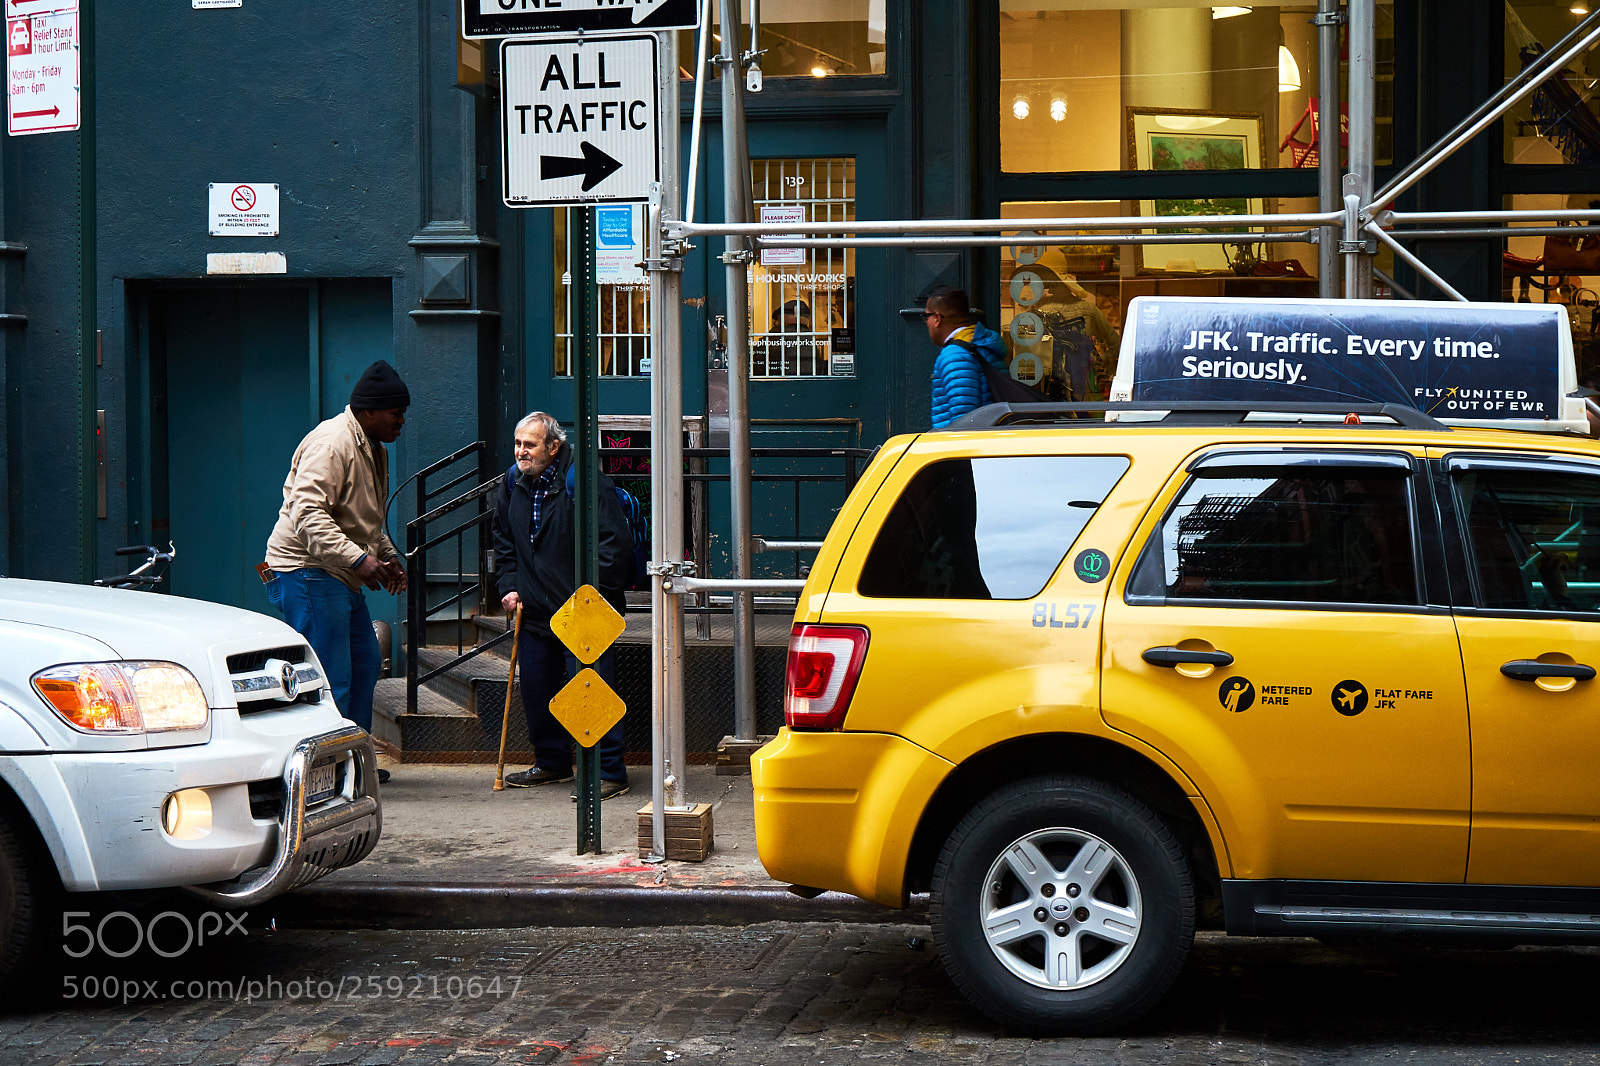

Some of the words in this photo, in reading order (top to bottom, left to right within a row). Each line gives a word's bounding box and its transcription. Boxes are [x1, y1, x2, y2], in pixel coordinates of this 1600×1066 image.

[34, 18, 47, 28] Taxi
[34, 28, 52, 40] Relief
[53, 26, 73, 39] Stand
[34, 43, 37, 54] 1
[38, 42, 53, 53] hour
[55, 39, 72, 52] Limit
[12, 68, 35, 81] Monday
[42, 65, 62, 78] Friday
[540, 52, 621, 91] ALL
[12, 84, 26, 95] 8am
[31, 82, 46, 94] 6pm
[514, 100, 647, 134] TRAFFIC
[785, 176, 805, 187] 130
[755, 273, 805, 283] HOUSING
[806, 273, 846, 283] WORKS
[748, 339, 831, 348] hophousingworks.com
[1183, 330, 1239, 352] JFK.
[1247, 332, 1338, 355] Traffic.
[1346, 335, 1426, 360] Every
[1433, 336, 1500, 359] time.
[1182, 355, 1307, 385] Seriously.
[1414, 388, 1444, 398] FLY
[1459, 389, 1528, 400] UNITED
[1447, 400, 1482, 410] OUT
[1483, 401, 1504, 410] OF
[1510, 401, 1544, 411] EWR
[1032, 602, 1097, 629] 8L57
[1261, 685, 1312, 696] METERED
[1374, 689, 1401, 699] FLAT
[1405, 690, 1433, 700] FARE
[1261, 696, 1289, 705] FARE
[1374, 700, 1396, 709] JFK
